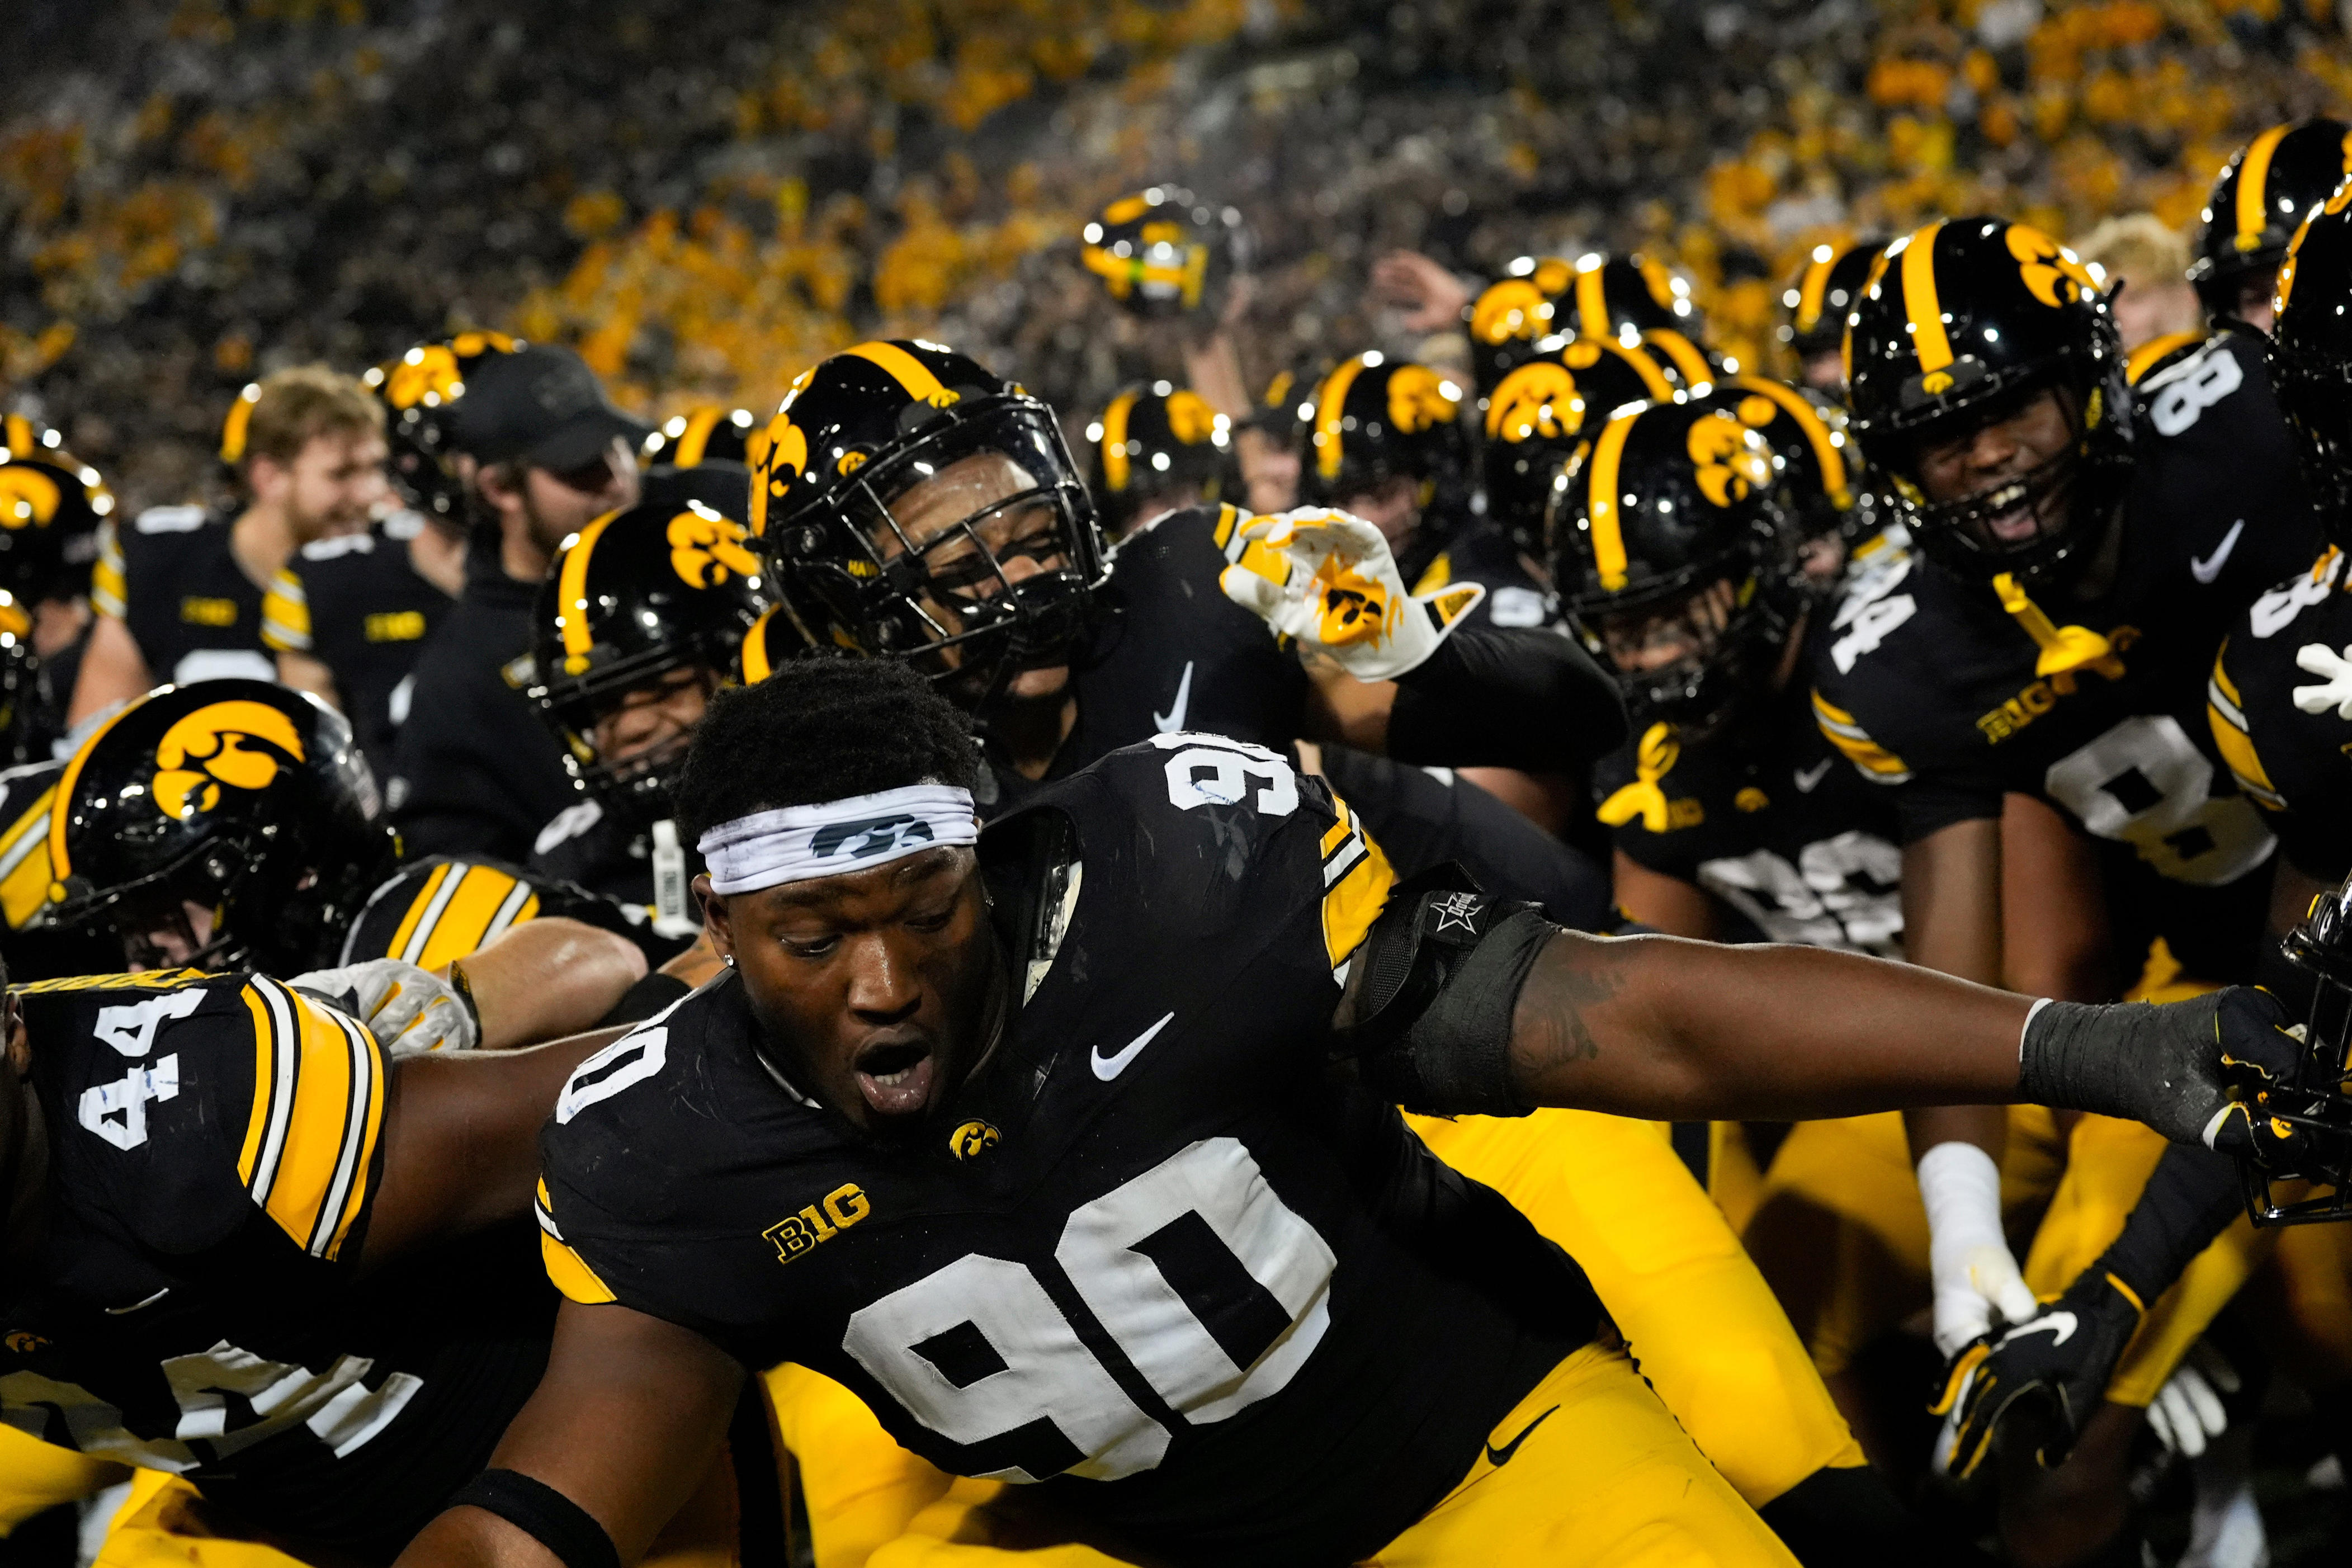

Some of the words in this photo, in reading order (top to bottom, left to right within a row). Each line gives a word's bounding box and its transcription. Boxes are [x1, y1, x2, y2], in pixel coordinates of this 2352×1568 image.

[2046, 714, 2279, 885] 8
[78, 989, 208, 1150] 44
[842, 1137, 1337, 1484] 90
